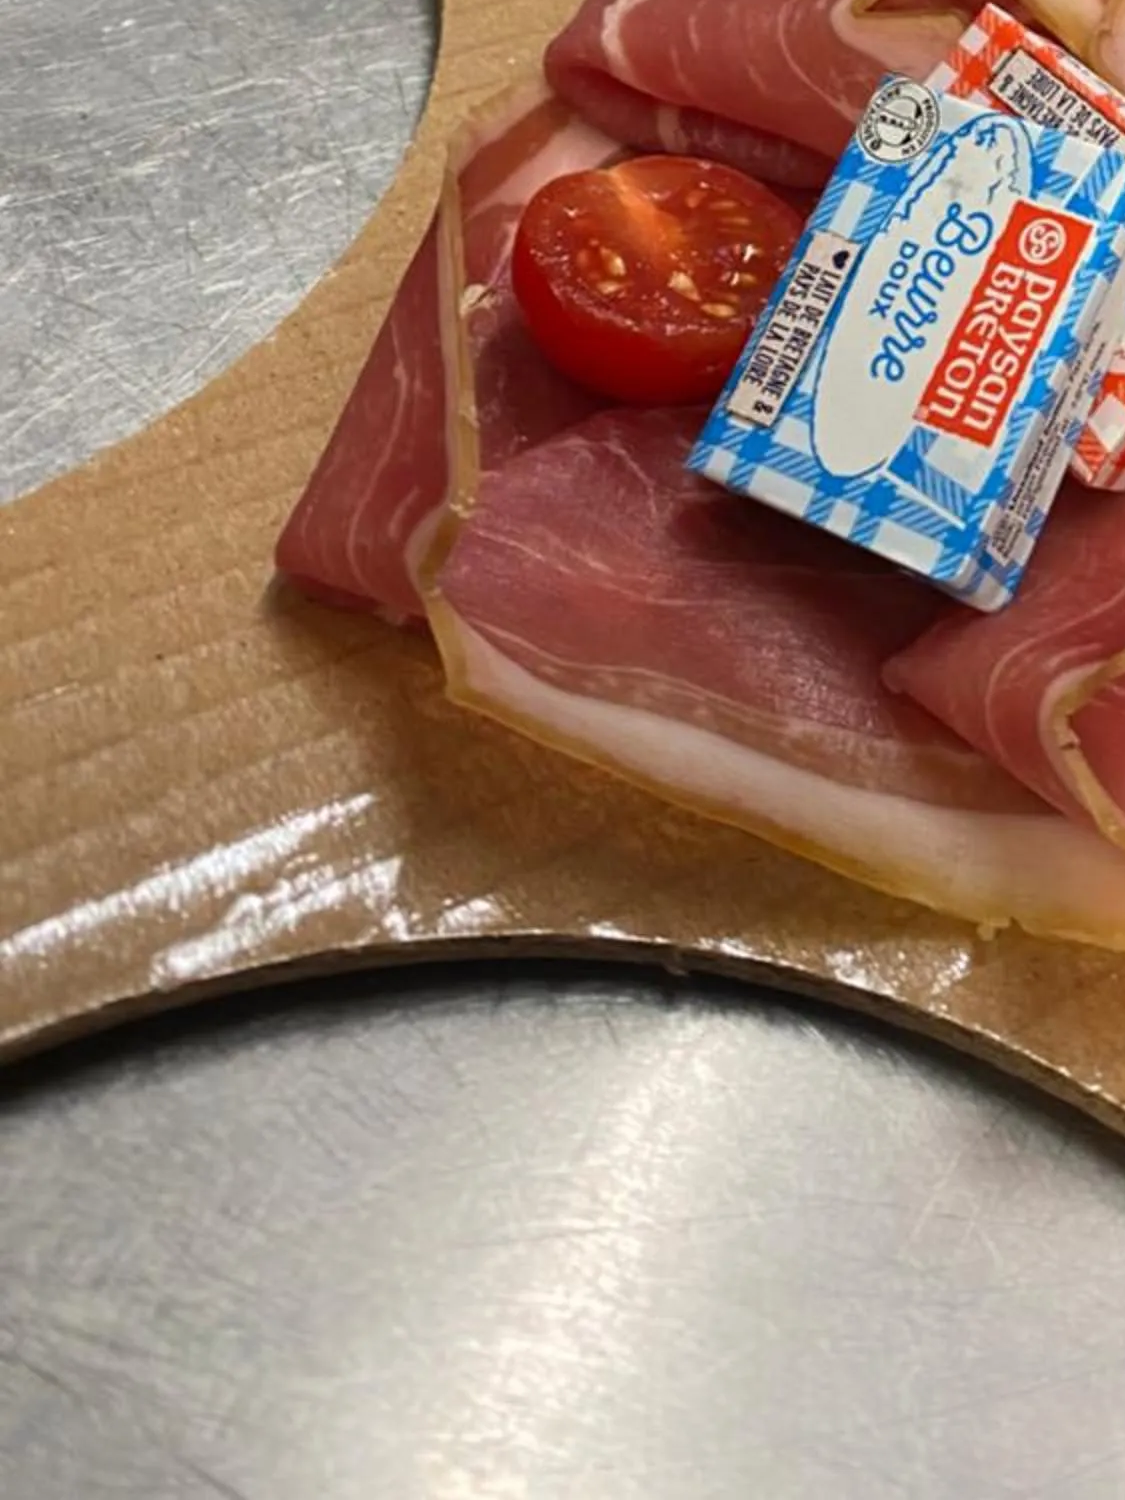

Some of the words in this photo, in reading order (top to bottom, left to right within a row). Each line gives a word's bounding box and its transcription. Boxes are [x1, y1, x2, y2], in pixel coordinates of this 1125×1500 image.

[790, 262, 820, 299] PAYS
[811, 270, 842, 306] LAIT
[869, 241, 920, 319] DOUX
[870, 202, 994, 382] Beurre
[777, 300, 800, 321] DE
[799, 305, 824, 328] DE
[766, 322, 791, 343] LA
[743, 346, 779, 387] LOIRE
[761, 327, 812, 400] BRETAGNE
[752, 400, 774, 414] &
